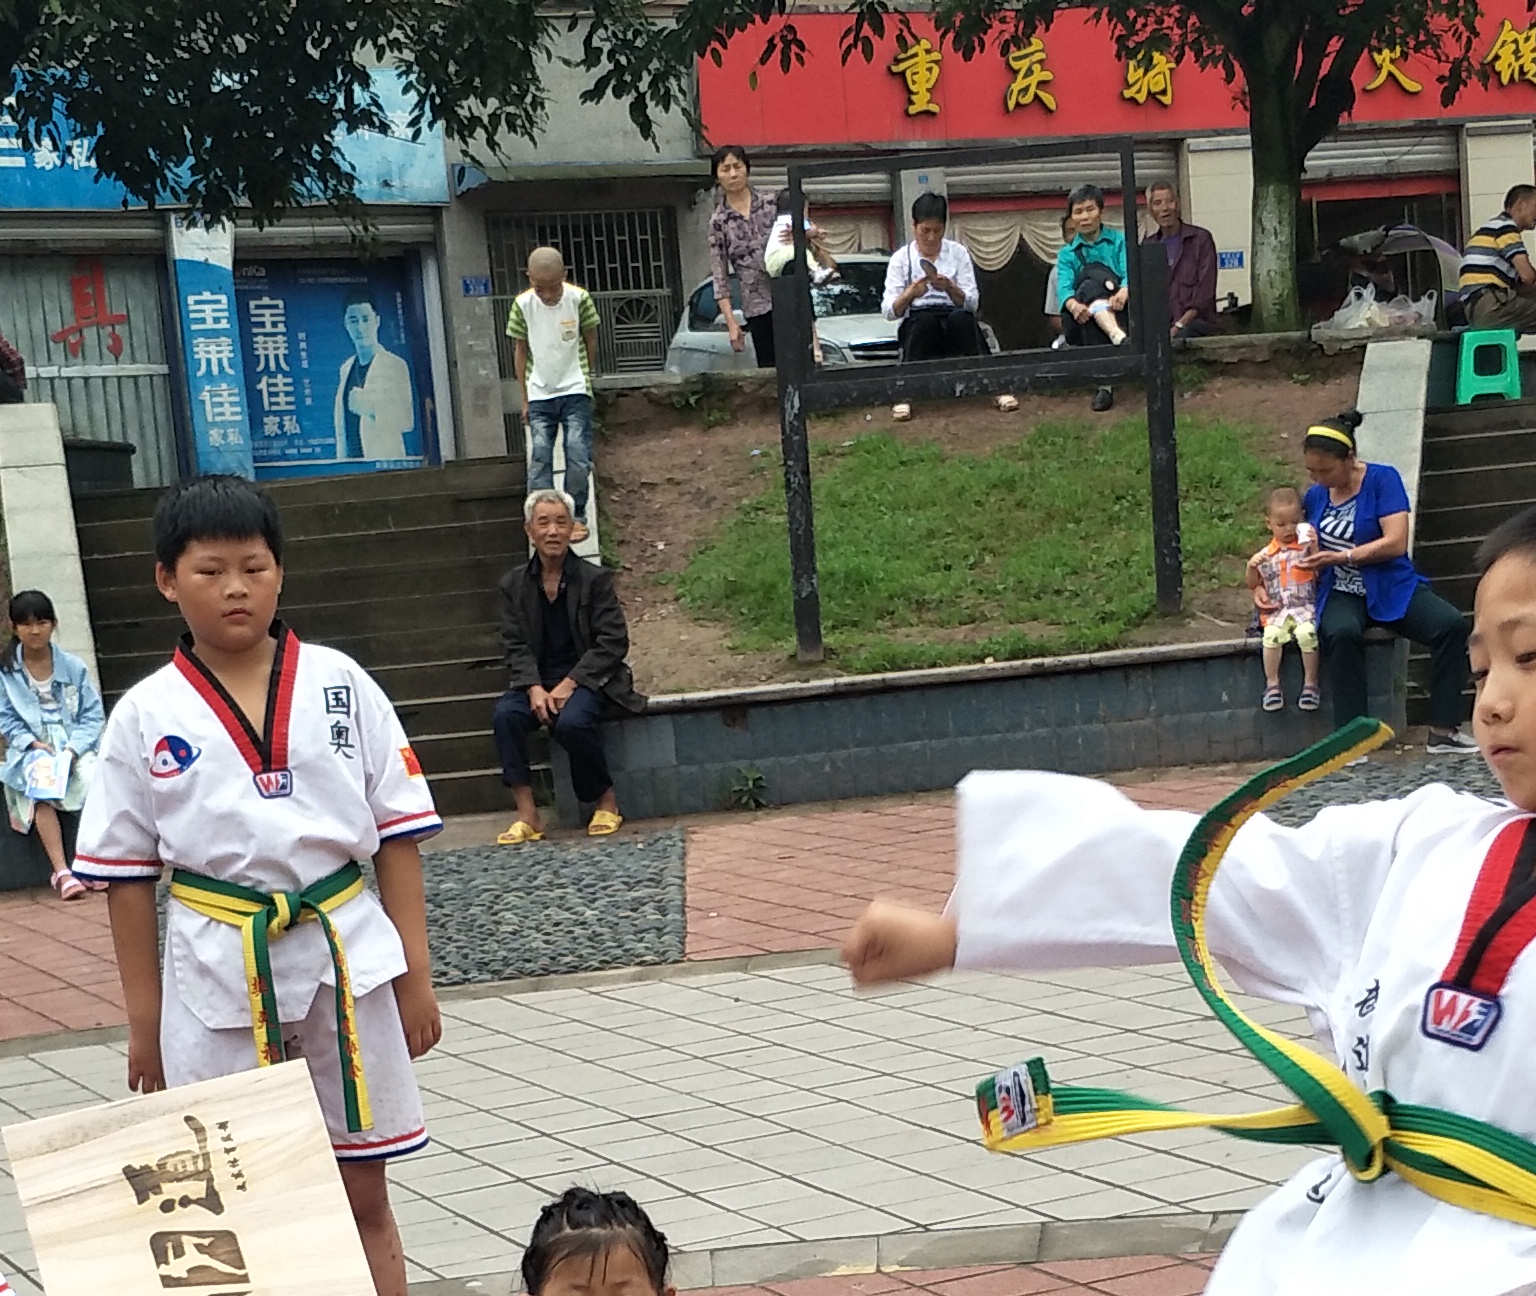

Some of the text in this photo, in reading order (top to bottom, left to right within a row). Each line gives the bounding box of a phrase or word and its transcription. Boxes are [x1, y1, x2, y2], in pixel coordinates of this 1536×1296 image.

[186, 290, 243, 423] 宝莱佳
[248, 296, 296, 412] 宝莱佳
[208, 427, 244, 448] 家私
[263, 414, 302, 438] 家私
[323, 684, 356, 760] 国奥
